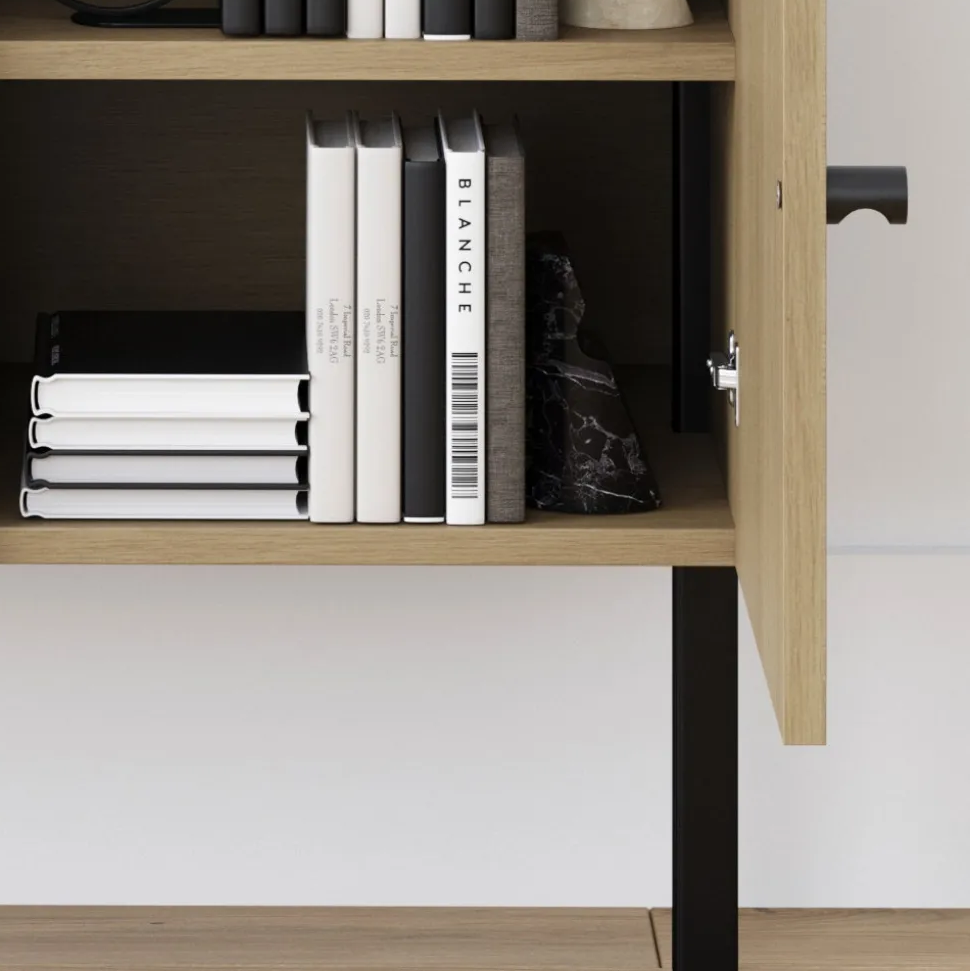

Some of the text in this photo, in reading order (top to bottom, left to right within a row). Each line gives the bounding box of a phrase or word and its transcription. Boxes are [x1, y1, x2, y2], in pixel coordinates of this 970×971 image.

[458, 178, 472, 313] BLANCHE
[329, 298, 339, 323] London
[376, 298, 386, 323] London
